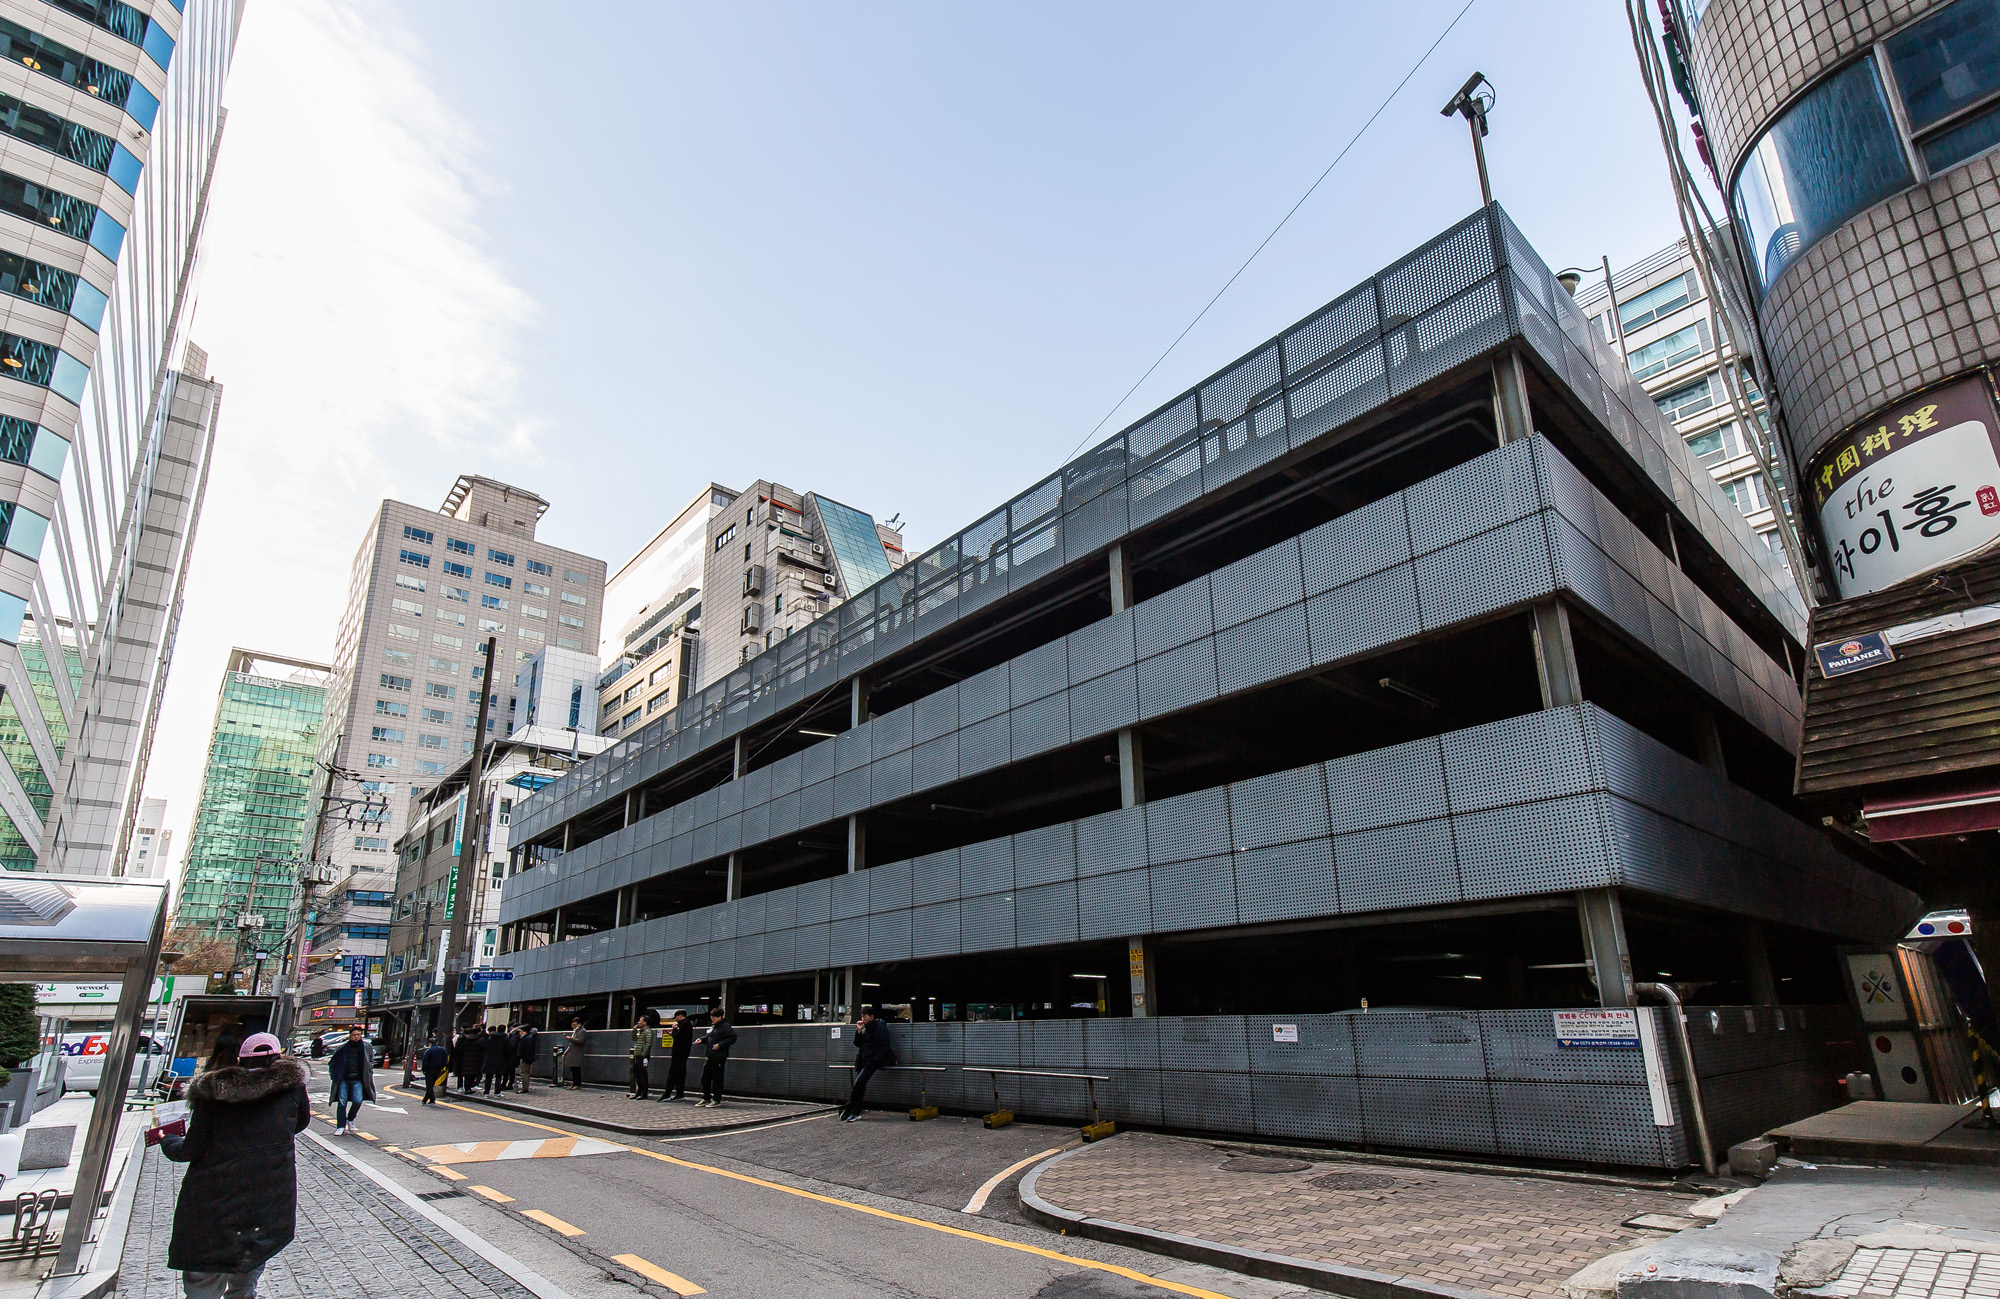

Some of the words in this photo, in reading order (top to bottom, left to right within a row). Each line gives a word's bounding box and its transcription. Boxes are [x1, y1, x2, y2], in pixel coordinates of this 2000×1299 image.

[1821, 405, 1939, 490] 中國料理
[1844, 476, 1895, 519] the
[1835, 484, 1972, 584] 차이홍
[1828, 649, 1883, 669] PAULANER
[354, 959, 364, 979] 세무사
[52, 1035, 109, 1056] edEx
